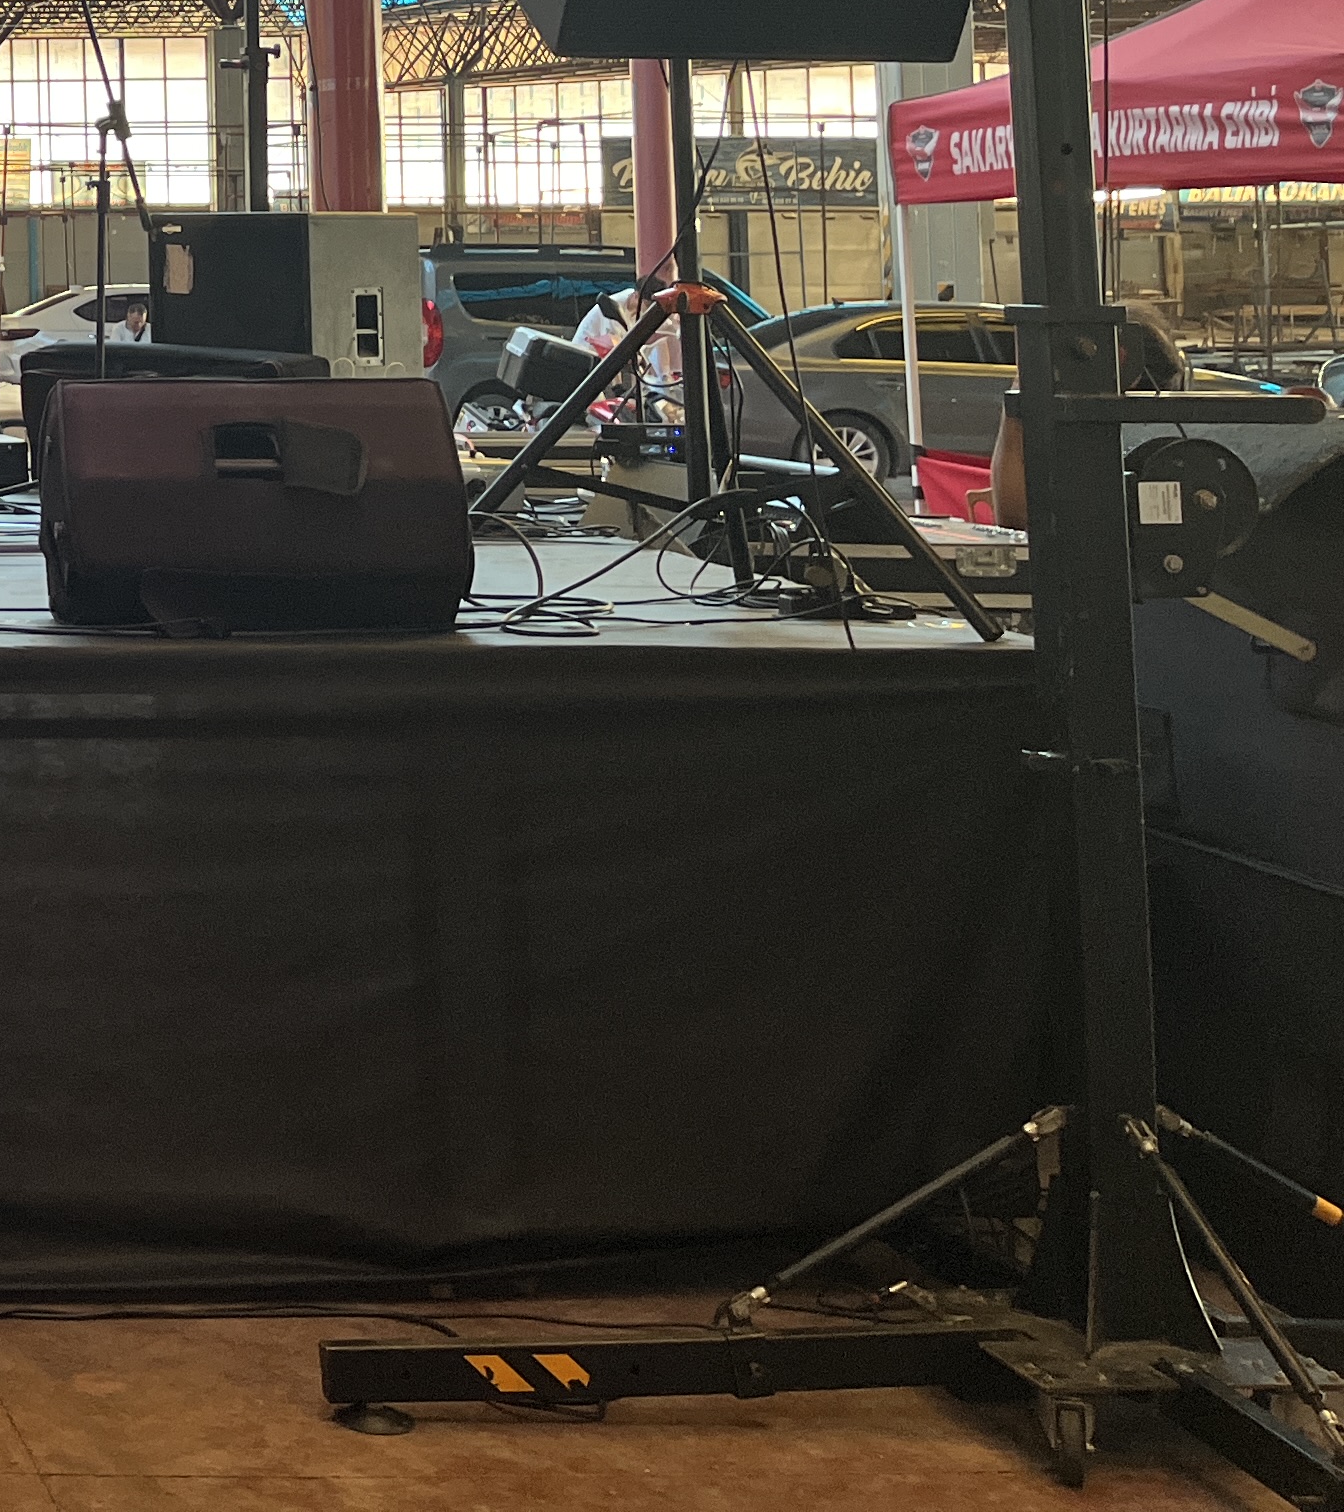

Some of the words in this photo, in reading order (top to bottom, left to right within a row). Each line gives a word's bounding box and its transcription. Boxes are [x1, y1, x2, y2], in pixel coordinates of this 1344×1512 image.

[949, 126, 1013, 176] SAKARY
[1107, 102, 1218, 158] KURTARMA
[1219, 84, 1280, 150] EKİBİ
[779, 156, 874, 197] Behiç
